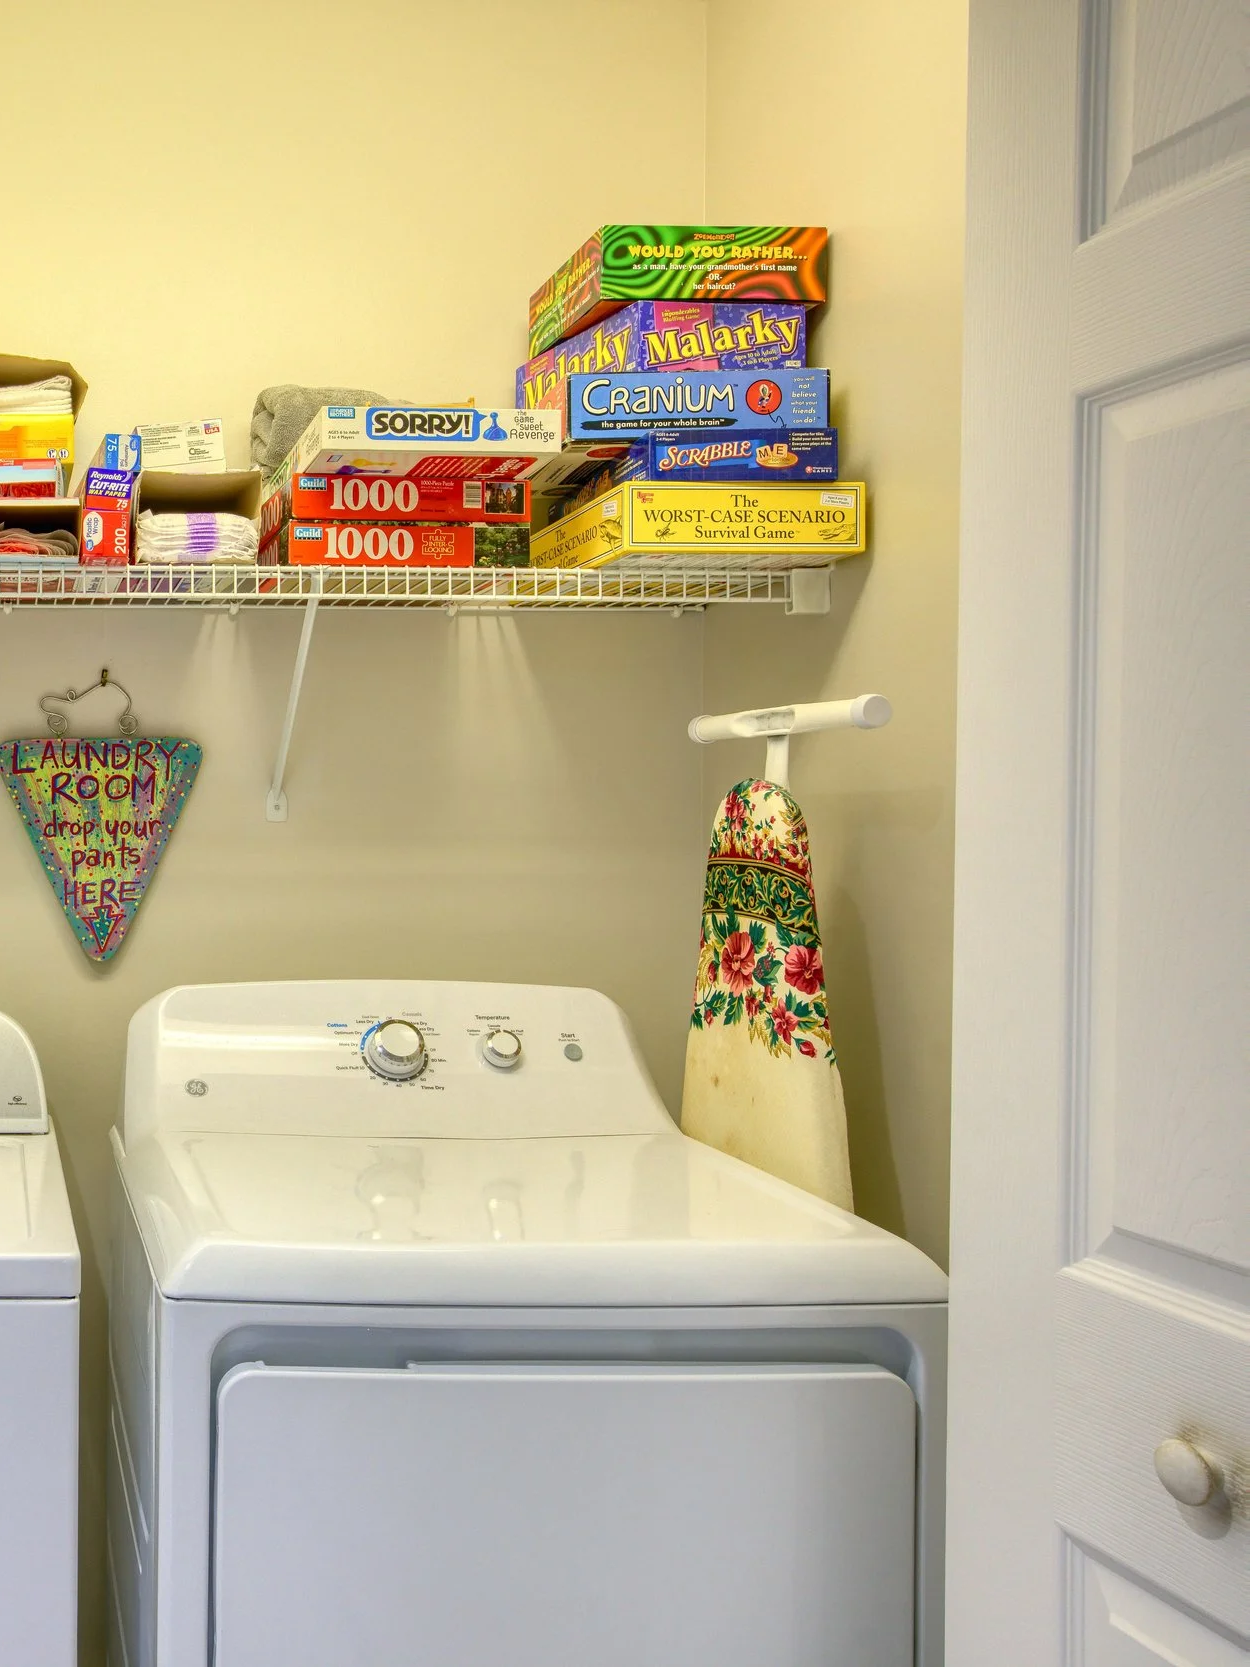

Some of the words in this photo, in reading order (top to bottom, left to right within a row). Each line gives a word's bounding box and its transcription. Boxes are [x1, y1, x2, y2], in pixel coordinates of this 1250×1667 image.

[627, 245, 685, 259] WOULD
[691, 245, 725, 259] YOU
[731, 246, 808, 260] RATHER...
[650, 264, 668, 273] man,
[669, 263, 687, 271] have
[688, 264, 705, 273] your
[707, 263, 759, 273] grandmother's
[760, 263, 776, 271] first
[706, 273, 723, 281] -OR-
[692, 282, 705, 290] her
[707, 282, 736, 290] haircut?
[535, 293, 554, 315] WOULD
[643, 309, 800, 367] Malarky
[758, 355, 778, 363] Players
[206, 426, 220, 434] USA
[373, 411, 472, 435] SORRY!
[601, 420, 614, 428] the
[652, 421, 670, 430] your
[673, 419, 697, 427] whole
[510, 428, 555, 443] Revenge
[107, 438, 118, 452] 75
[659, 440, 753, 470] SCRABBLE
[90, 471, 123, 482] Reynolds
[299, 478, 326, 489] Guild
[89, 480, 130, 492] CUT-RITE
[105, 490, 127, 498] PAPER
[330, 478, 419, 513] 1000
[116, 499, 128, 508] 75
[730, 495, 759, 508] The
[643, 510, 754, 523] WORST-CASE
[757, 510, 846, 523] SCENARIO
[294, 528, 322, 538] Guild
[555, 529, 566, 543] The
[565, 525, 598, 553] SCENARIO
[694, 526, 750, 539] Survival
[753, 526, 795, 539] Game
[114, 528, 127, 554] 200
[324, 526, 414, 560] 1000
[12, 740, 182, 781] LAUNDRY
[51, 771, 156, 805] ROOM
[42, 809, 95, 846] drop
[104, 818, 162, 846] your
[71, 837, 141, 877] pants
[63, 878, 142, 909] HERE
